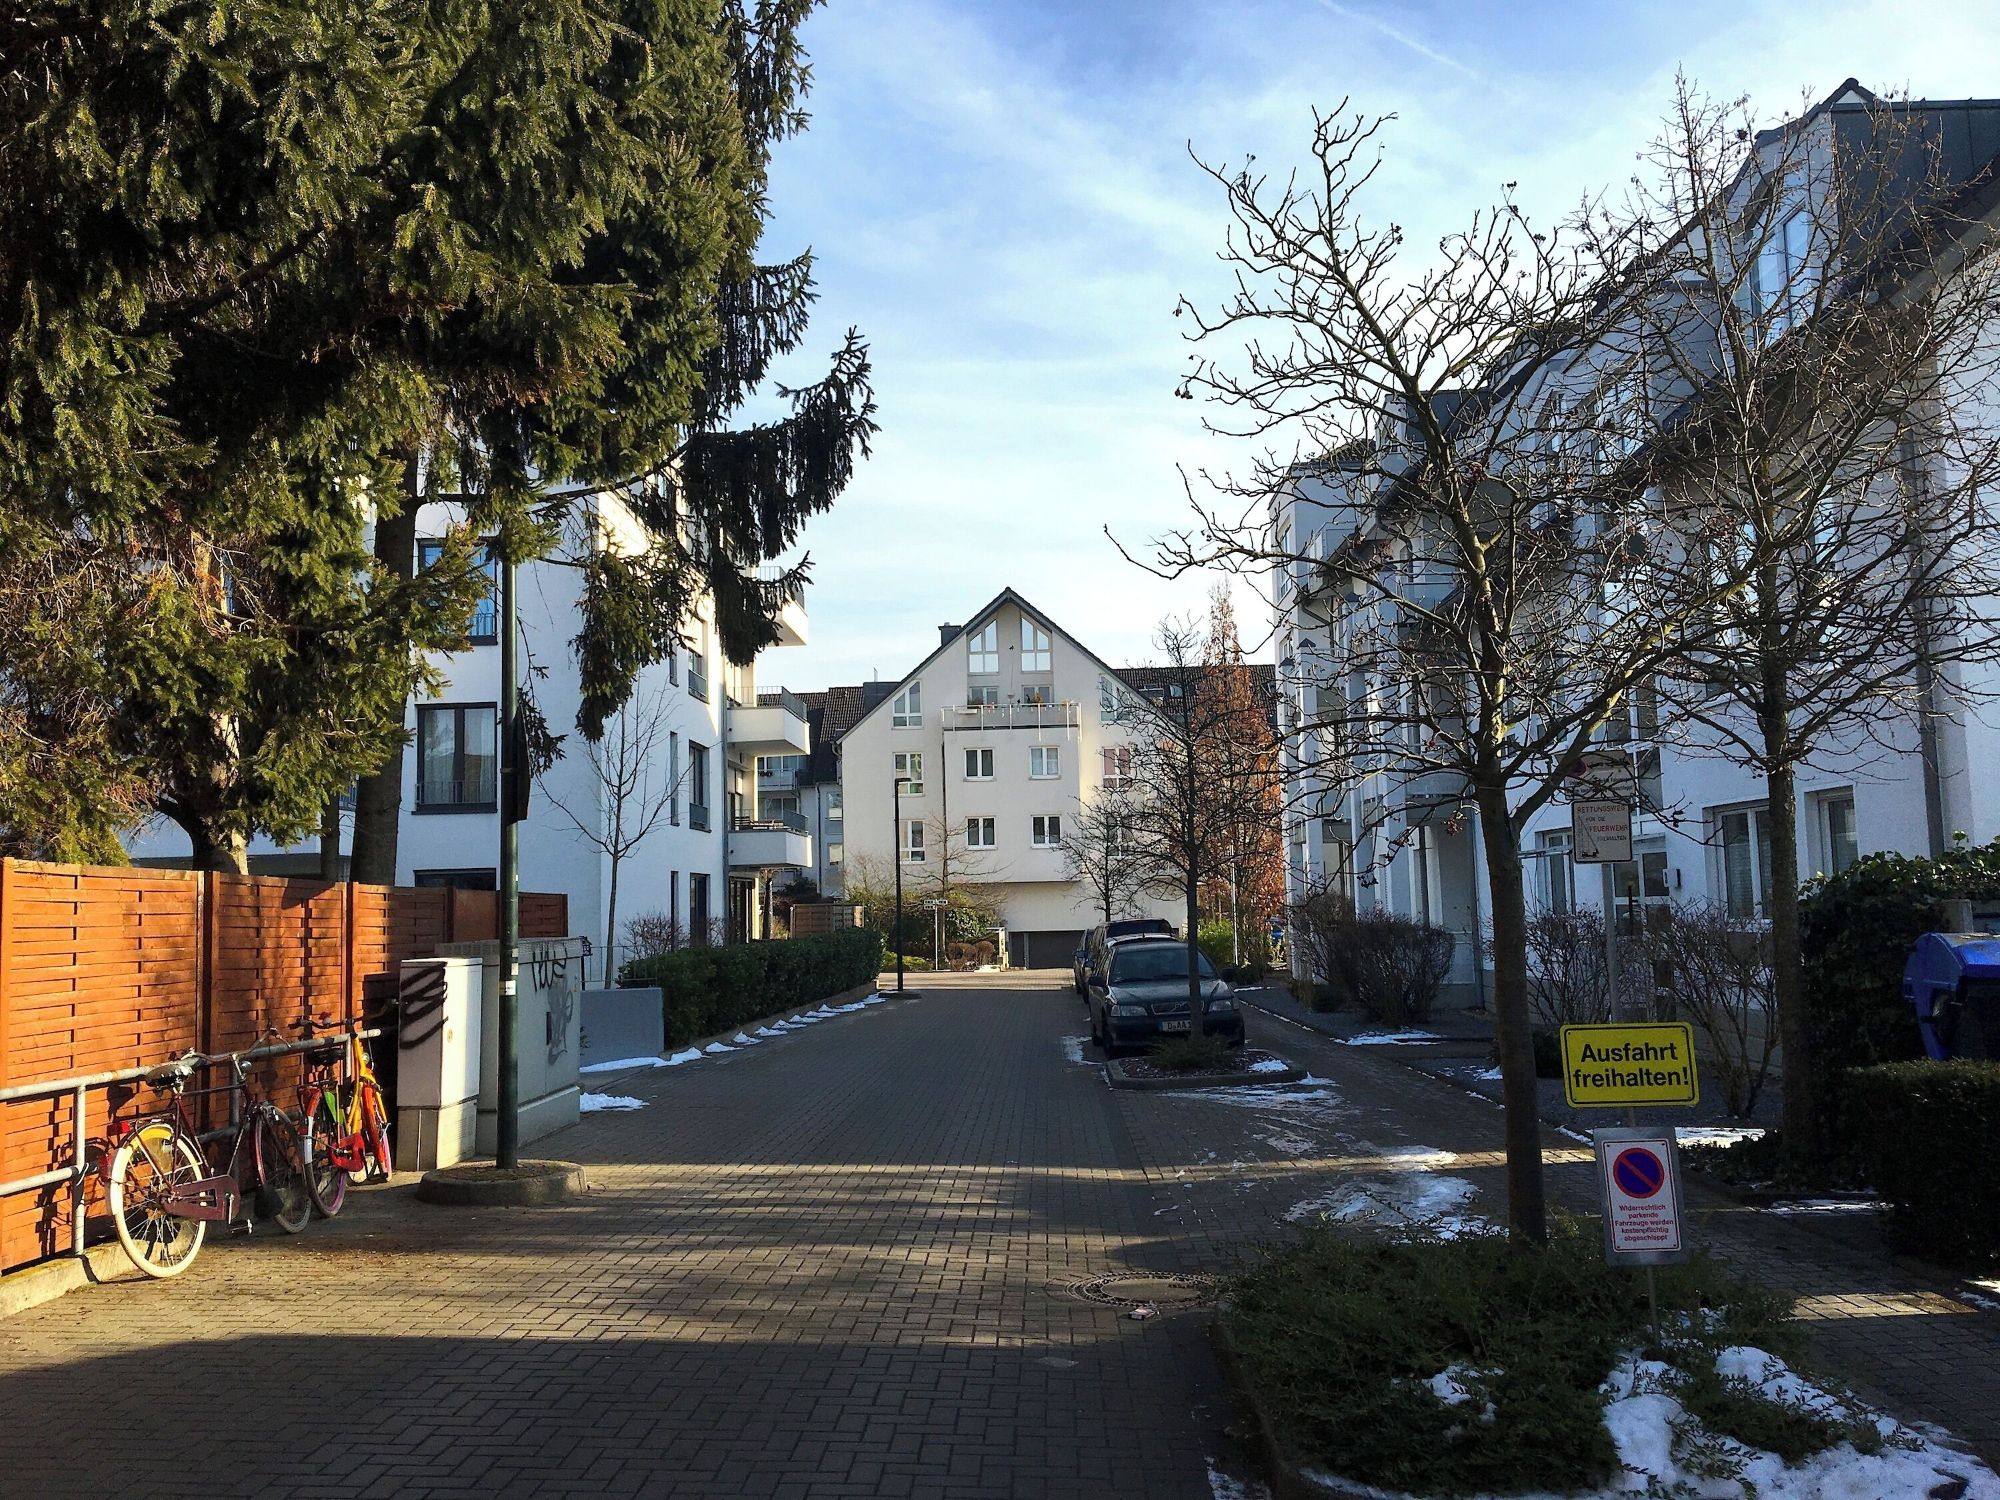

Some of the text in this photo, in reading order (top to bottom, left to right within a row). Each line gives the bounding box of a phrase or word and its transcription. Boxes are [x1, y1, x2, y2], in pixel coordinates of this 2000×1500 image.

[1589, 824, 1628, 832] FEUERWEHR
[1581, 1042, 1678, 1062] Ausfahrt
[1573, 1067, 1689, 1088] freihalten!
